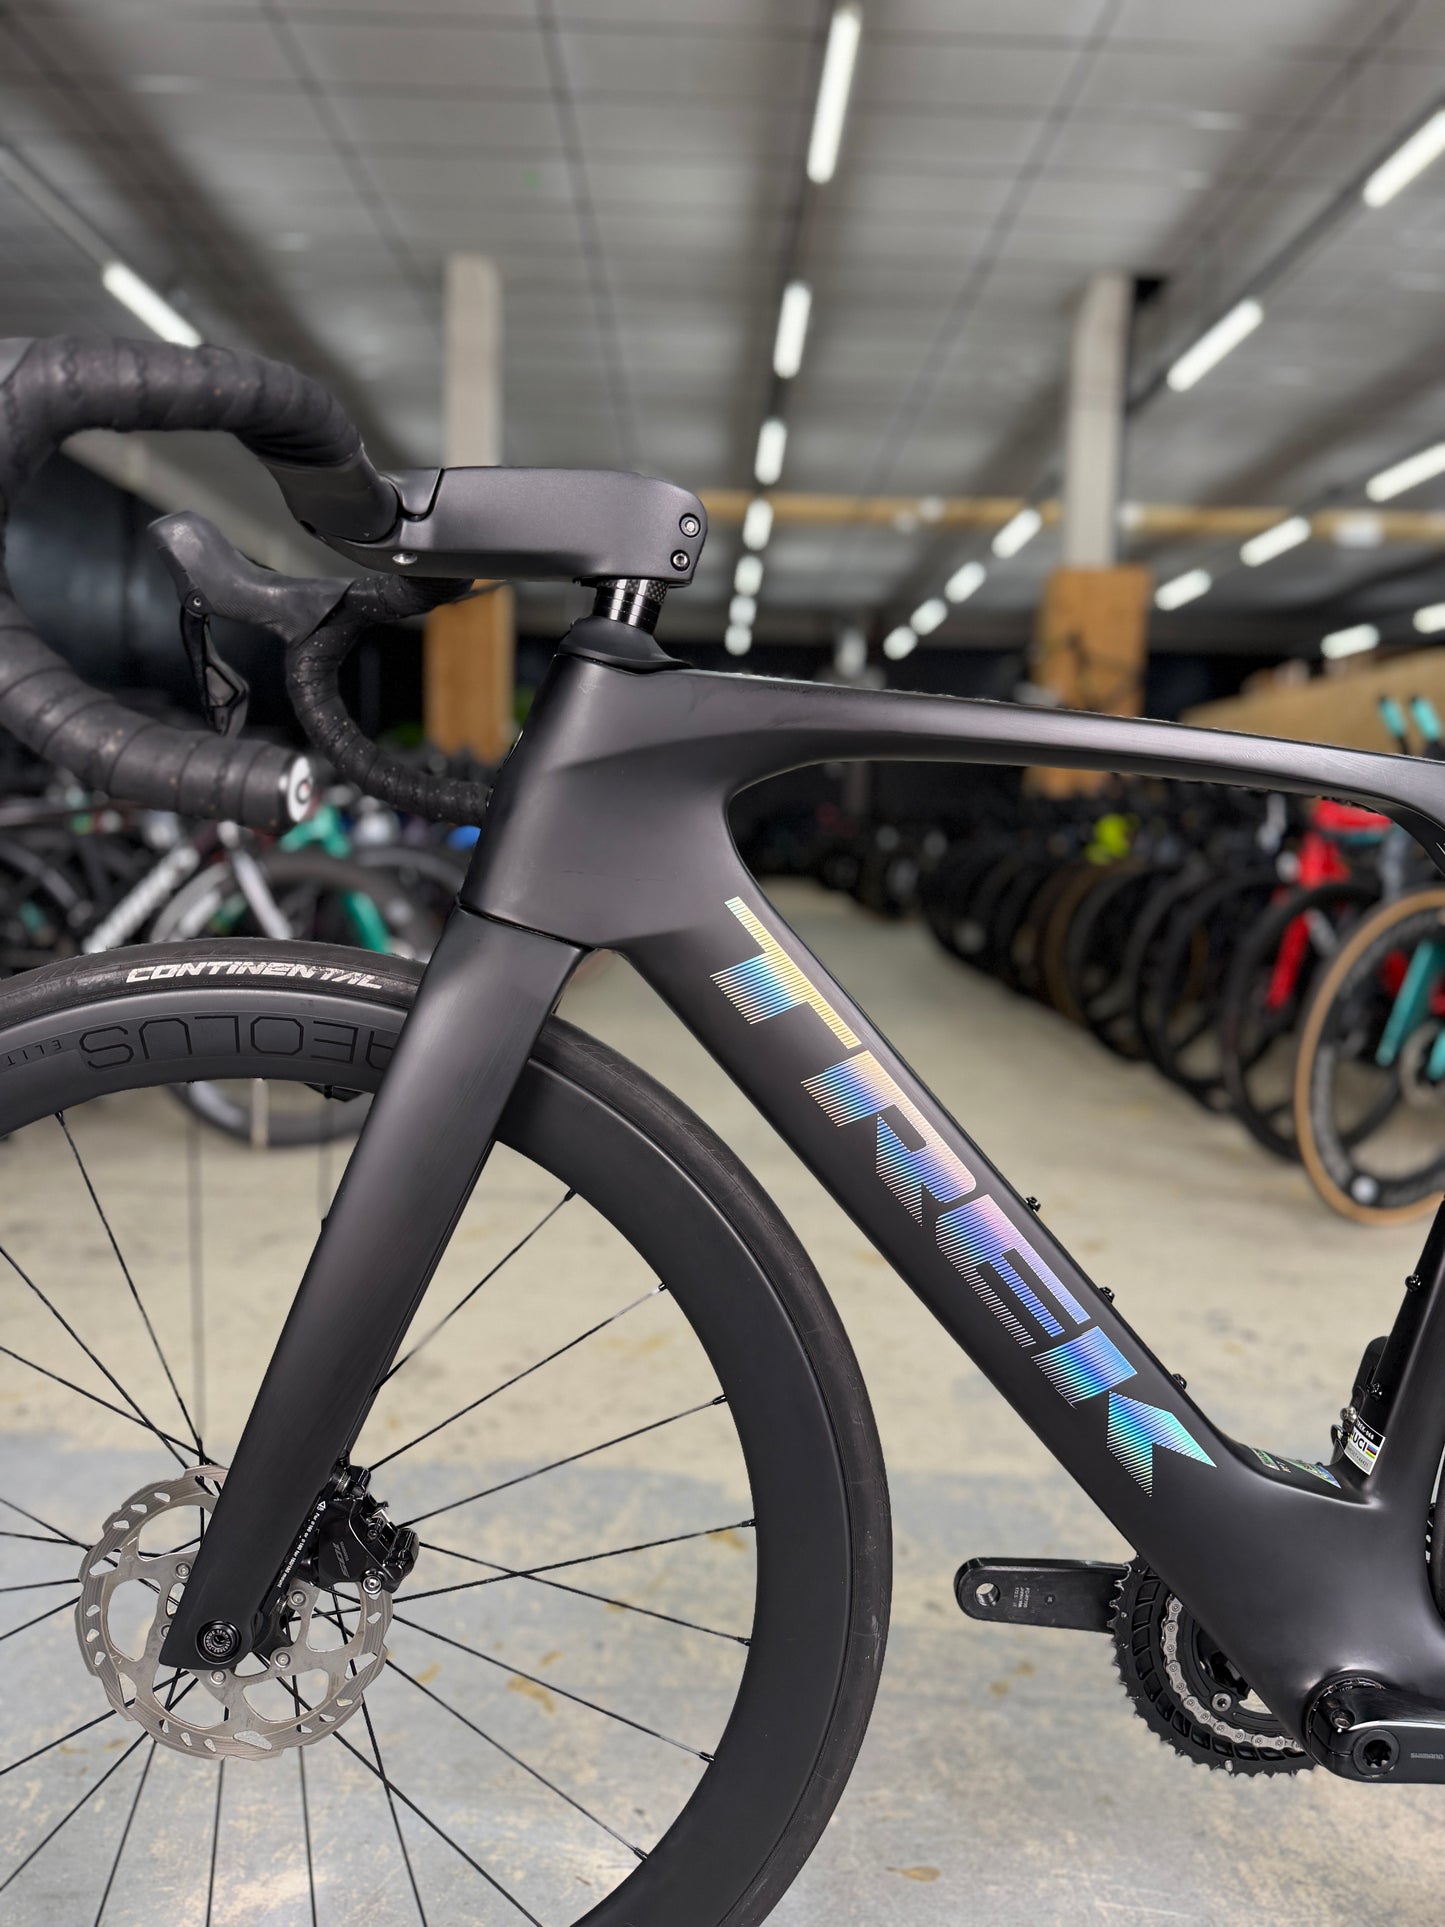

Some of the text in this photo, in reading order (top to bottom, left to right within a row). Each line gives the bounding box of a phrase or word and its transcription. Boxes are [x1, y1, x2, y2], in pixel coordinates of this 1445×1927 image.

[126, 961, 382, 989] CONTINENTAL
[710, 897, 1217, 1497] TREK
[1353, 1431, 1367, 1452] UCI
